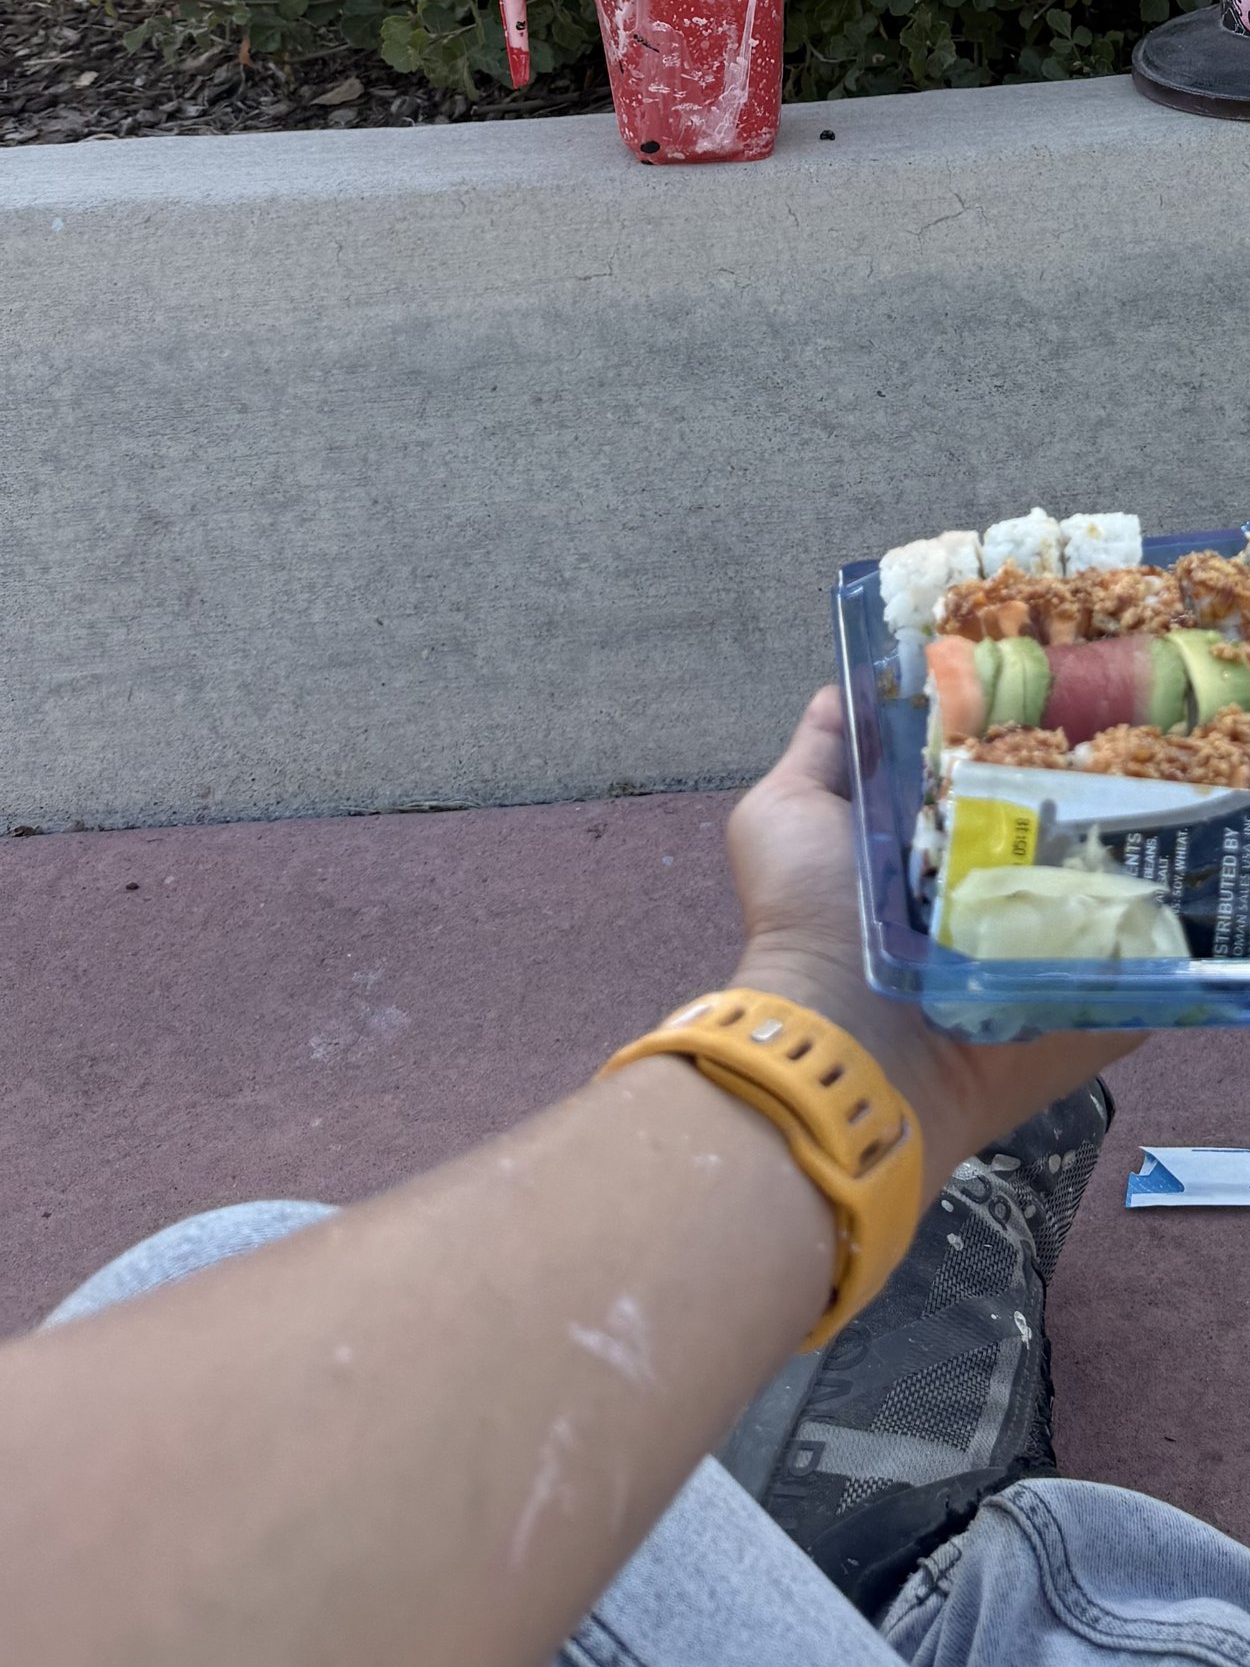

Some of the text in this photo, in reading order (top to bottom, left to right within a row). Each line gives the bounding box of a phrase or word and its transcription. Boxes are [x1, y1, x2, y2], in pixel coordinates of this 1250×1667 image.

[1174, 828, 1189, 870] WHEAT.
[1214, 827, 1238, 958] ISTRIBUTED BY
[1238, 873, 1250, 911] SALES
